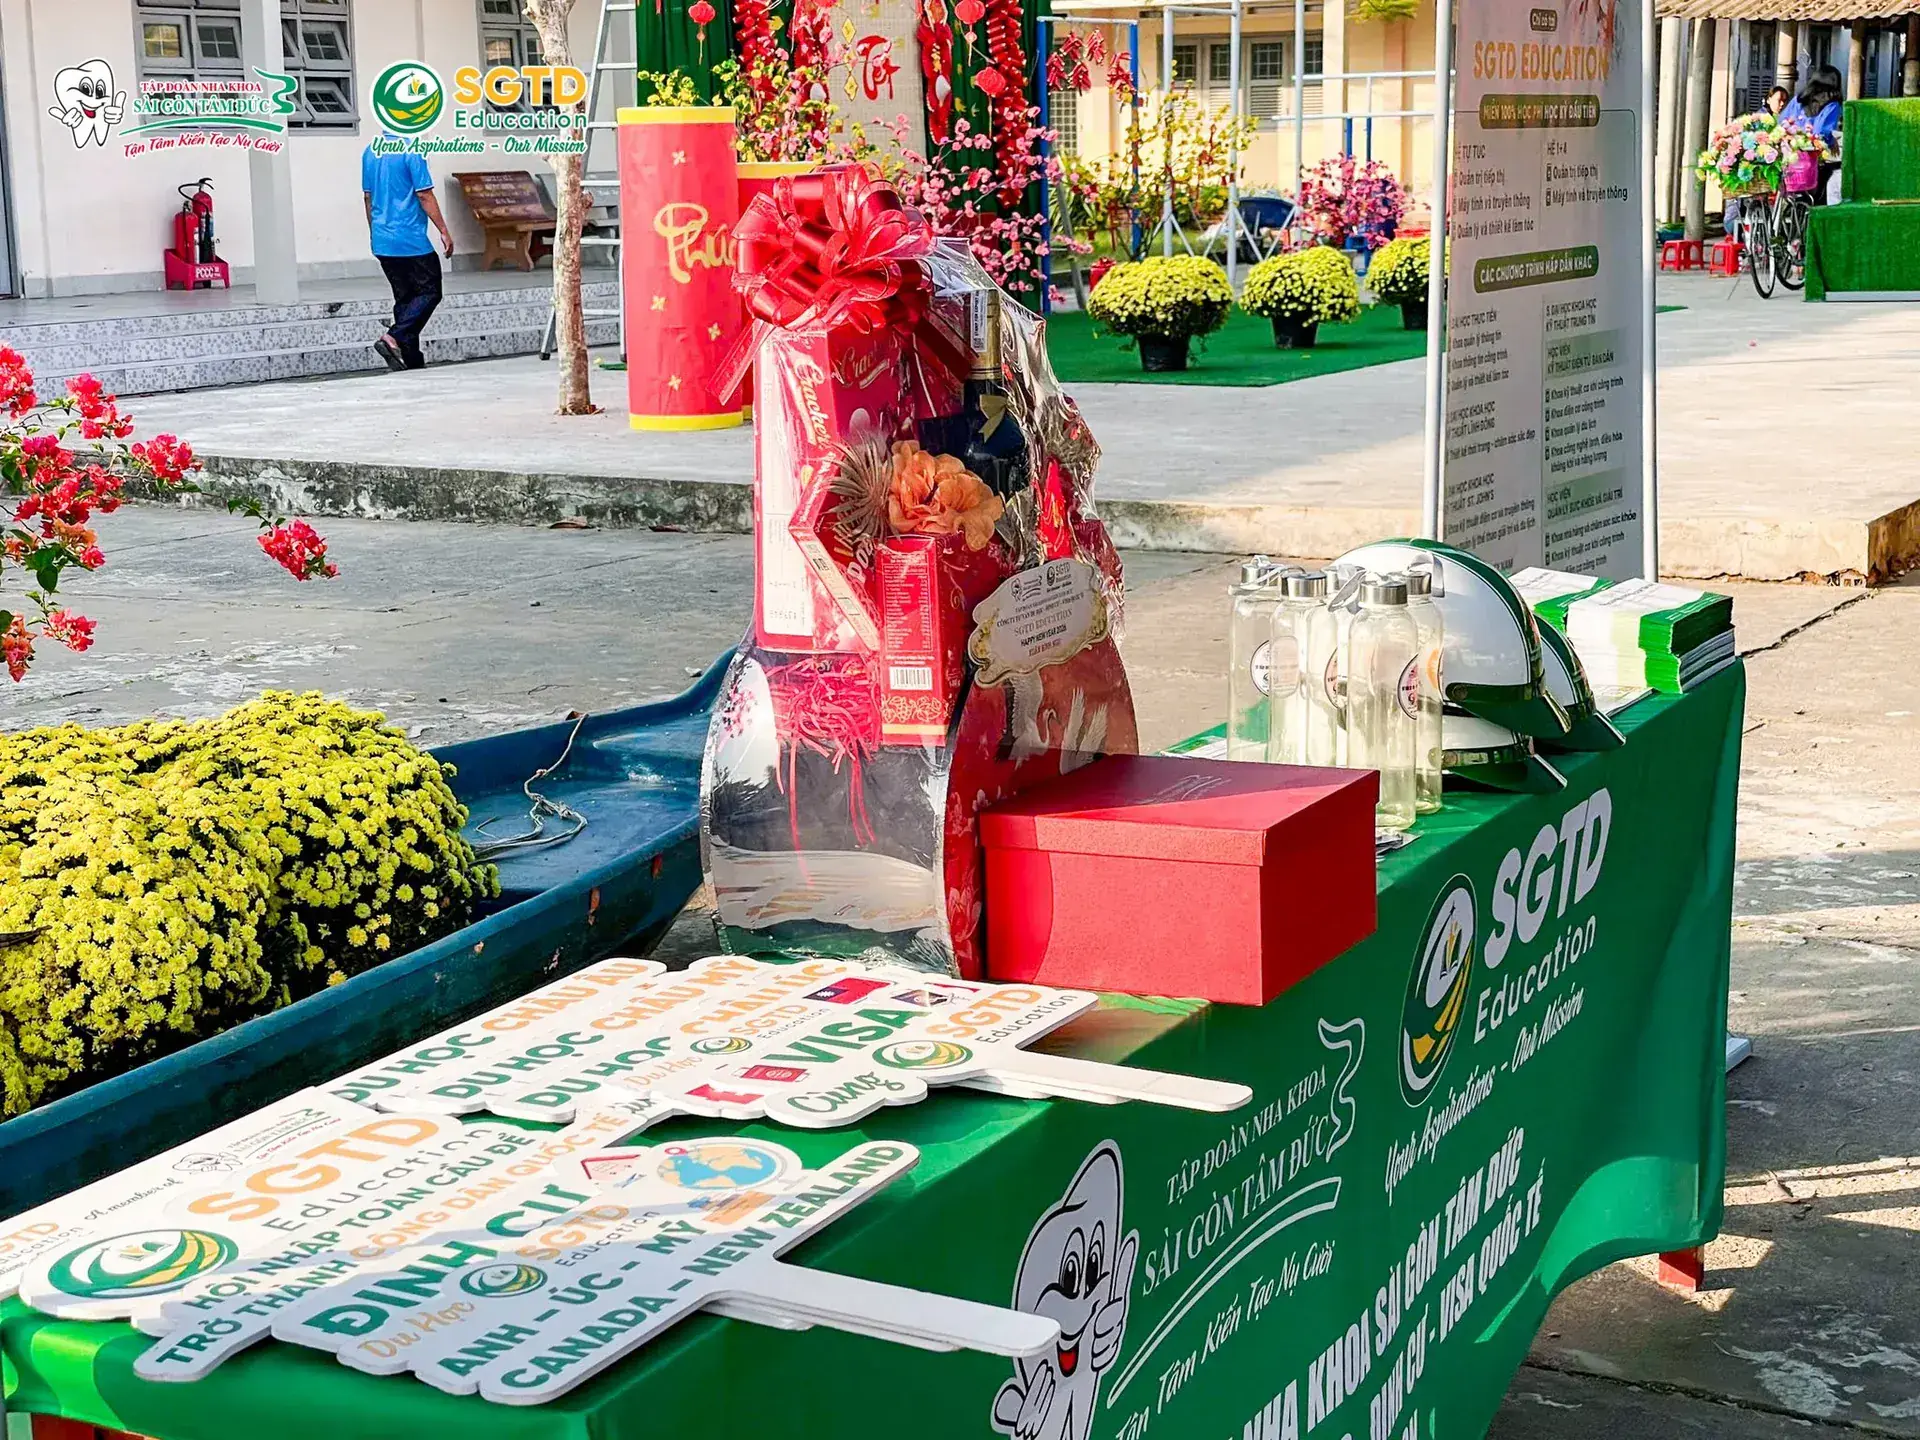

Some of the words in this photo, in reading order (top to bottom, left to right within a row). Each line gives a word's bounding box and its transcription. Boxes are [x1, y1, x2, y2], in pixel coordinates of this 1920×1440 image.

[1473, 40, 1517, 80] SGTD
[1521, 43, 1609, 82] EDUCATION
[1544, 104, 1559, 124] HỌC
[195, 267, 214, 279] PCCC
[1484, 788, 1612, 970] SGTD
[428, 1071, 512, 1100] DU
[493, 1032, 604, 1072] HỌC
[589, 983, 706, 1031] CHÂU
[687, 960, 759, 987] MỸ
[729, 1004, 808, 1036] SGTD
[757, 1008, 831, 1040] Education
[926, 988, 1043, 1039] SGTD
[975, 994, 1078, 1045] Education
[1473, 914, 1597, 1044] Education
[329, 1075, 402, 1102] DU
[381, 1033, 496, 1075] HỌC
[481, 983, 600, 1031] CHÂU
[760, 1009, 931, 1064] VISA
[515, 1077, 601, 1108] DU
[1167, 1156, 1201, 1206] TẬP
[1203, 1121, 1250, 1181] ĐOÀN
[1250, 1097, 1284, 1144] NHA
[1287, 1065, 1327, 1116] KHOA
[1384, 1130, 1418, 1207] Your
[1417, 1064, 1498, 1165] Aspirations
[1511, 1020, 1539, 1074] Our
[1537, 981, 1586, 1052] Mission
[108, 1185, 164, 1213] member
[187, 1116, 440, 1223] SGTD
[261, 1128, 493, 1233] Education
[1142, 1226, 1184, 1297] SÀI
[1188, 1188, 1237, 1261] GÒN
[1238, 1155, 1286, 1221] TÂM
[1288, 1114, 1332, 1185] ĐỨC
[155, 1317, 243, 1364] TRỞ
[233, 1258, 360, 1317] THÀNH
[350, 1210, 452, 1260] CÔNG
[441, 1175, 519, 1210] DÂN
[181, 1275, 262, 1311] HỘI
[249, 1230, 341, 1277] NHẬP
[336, 1186, 436, 1229] TOÀN
[500, 1294, 678, 1388] CANADA
[680, 1226, 777, 1276] NEW
[761, 1145, 903, 1229] ZEALAND
[515, 1204, 630, 1262] SGTD
[555, 1210, 661, 1268] Education
[1440, 1252, 1476, 1344] VISA
[1478, 1192, 1523, 1296] QUỐC
[1524, 1156, 1546, 1238] TẾ
[357, 1330, 421, 1358] Du
[405, 1300, 475, 1333] Học
[437, 1323, 541, 1377] ANH
[548, 1271, 624, 1306] ÚC
[636, 1219, 707, 1255] MỸ
[1157, 1349, 1198, 1415] Tâm
[1202, 1292, 1243, 1365] Kiến
[1246, 1276, 1276, 1324] Tạo
[1277, 1252, 1301, 1297] Nụ
[1303, 1240, 1336, 1284] Cười
[1307, 1308, 1372, 1434] KHOA
[1375, 1260, 1402, 1357] SÀI
[1405, 1211, 1441, 1311] GÒN
[1444, 1165, 1485, 1260] TÂM
